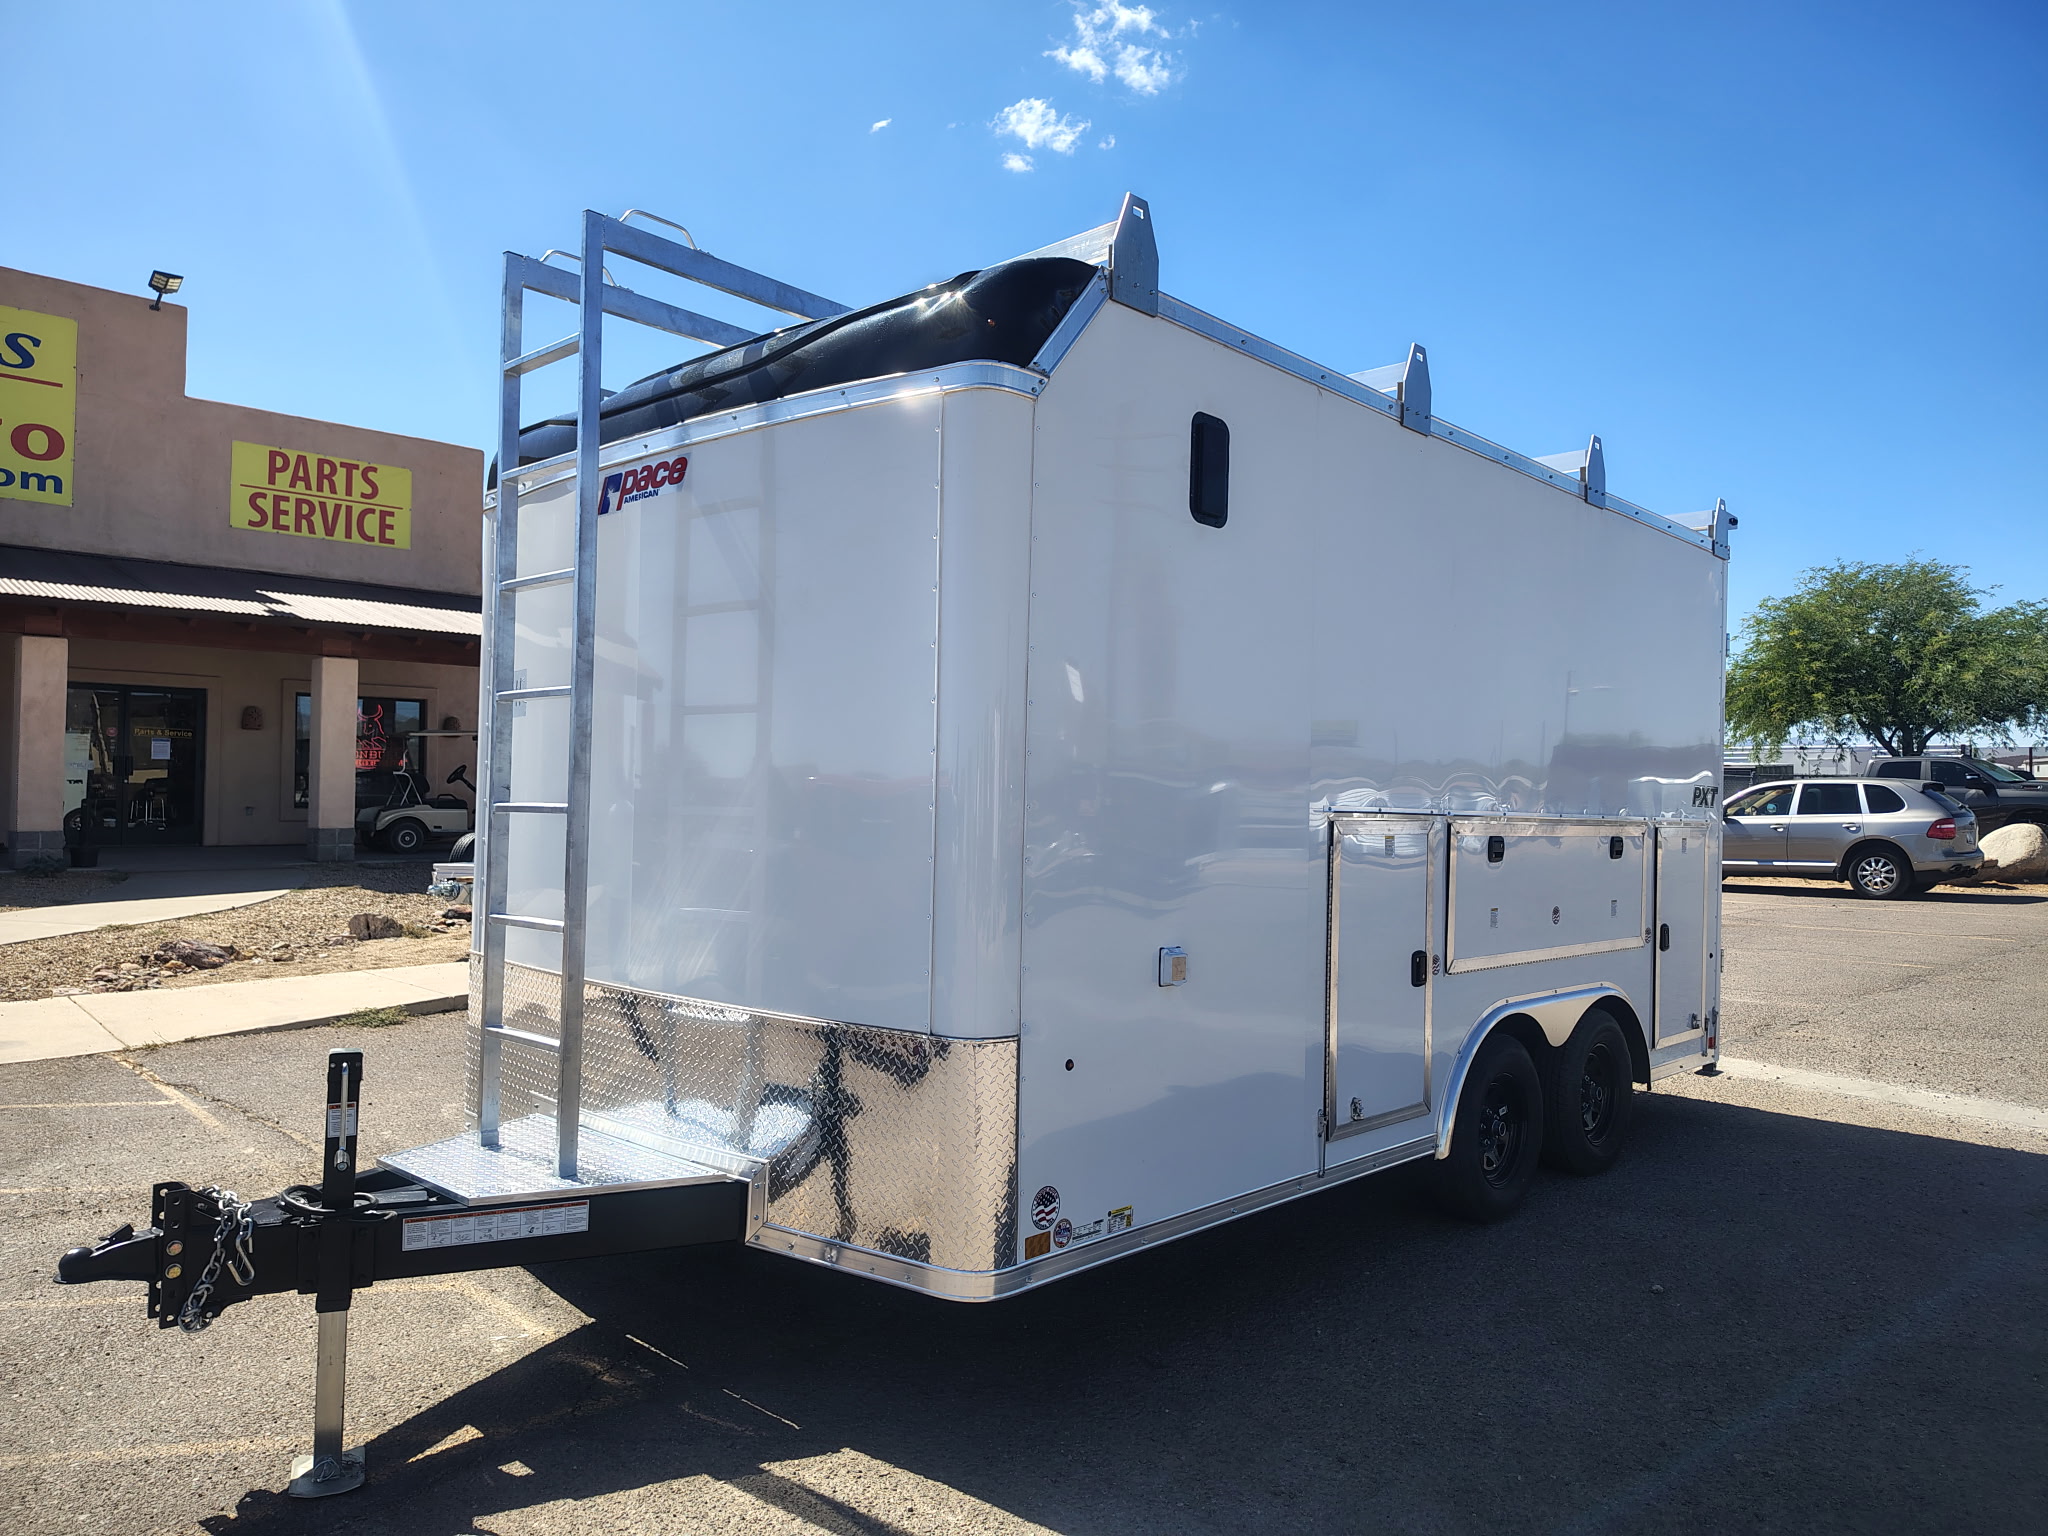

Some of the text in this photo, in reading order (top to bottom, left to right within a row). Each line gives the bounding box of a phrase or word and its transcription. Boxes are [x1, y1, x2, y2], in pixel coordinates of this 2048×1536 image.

[267, 450, 380, 500] PARTS
[615, 456, 688, 511] pace
[623, 488, 659, 505] AMERICAN
[247, 491, 395, 545] SERVICE
[134, 727, 155, 736] Parts
[164, 729, 193, 738] Service
[1691, 784, 1719, 809] PXT
